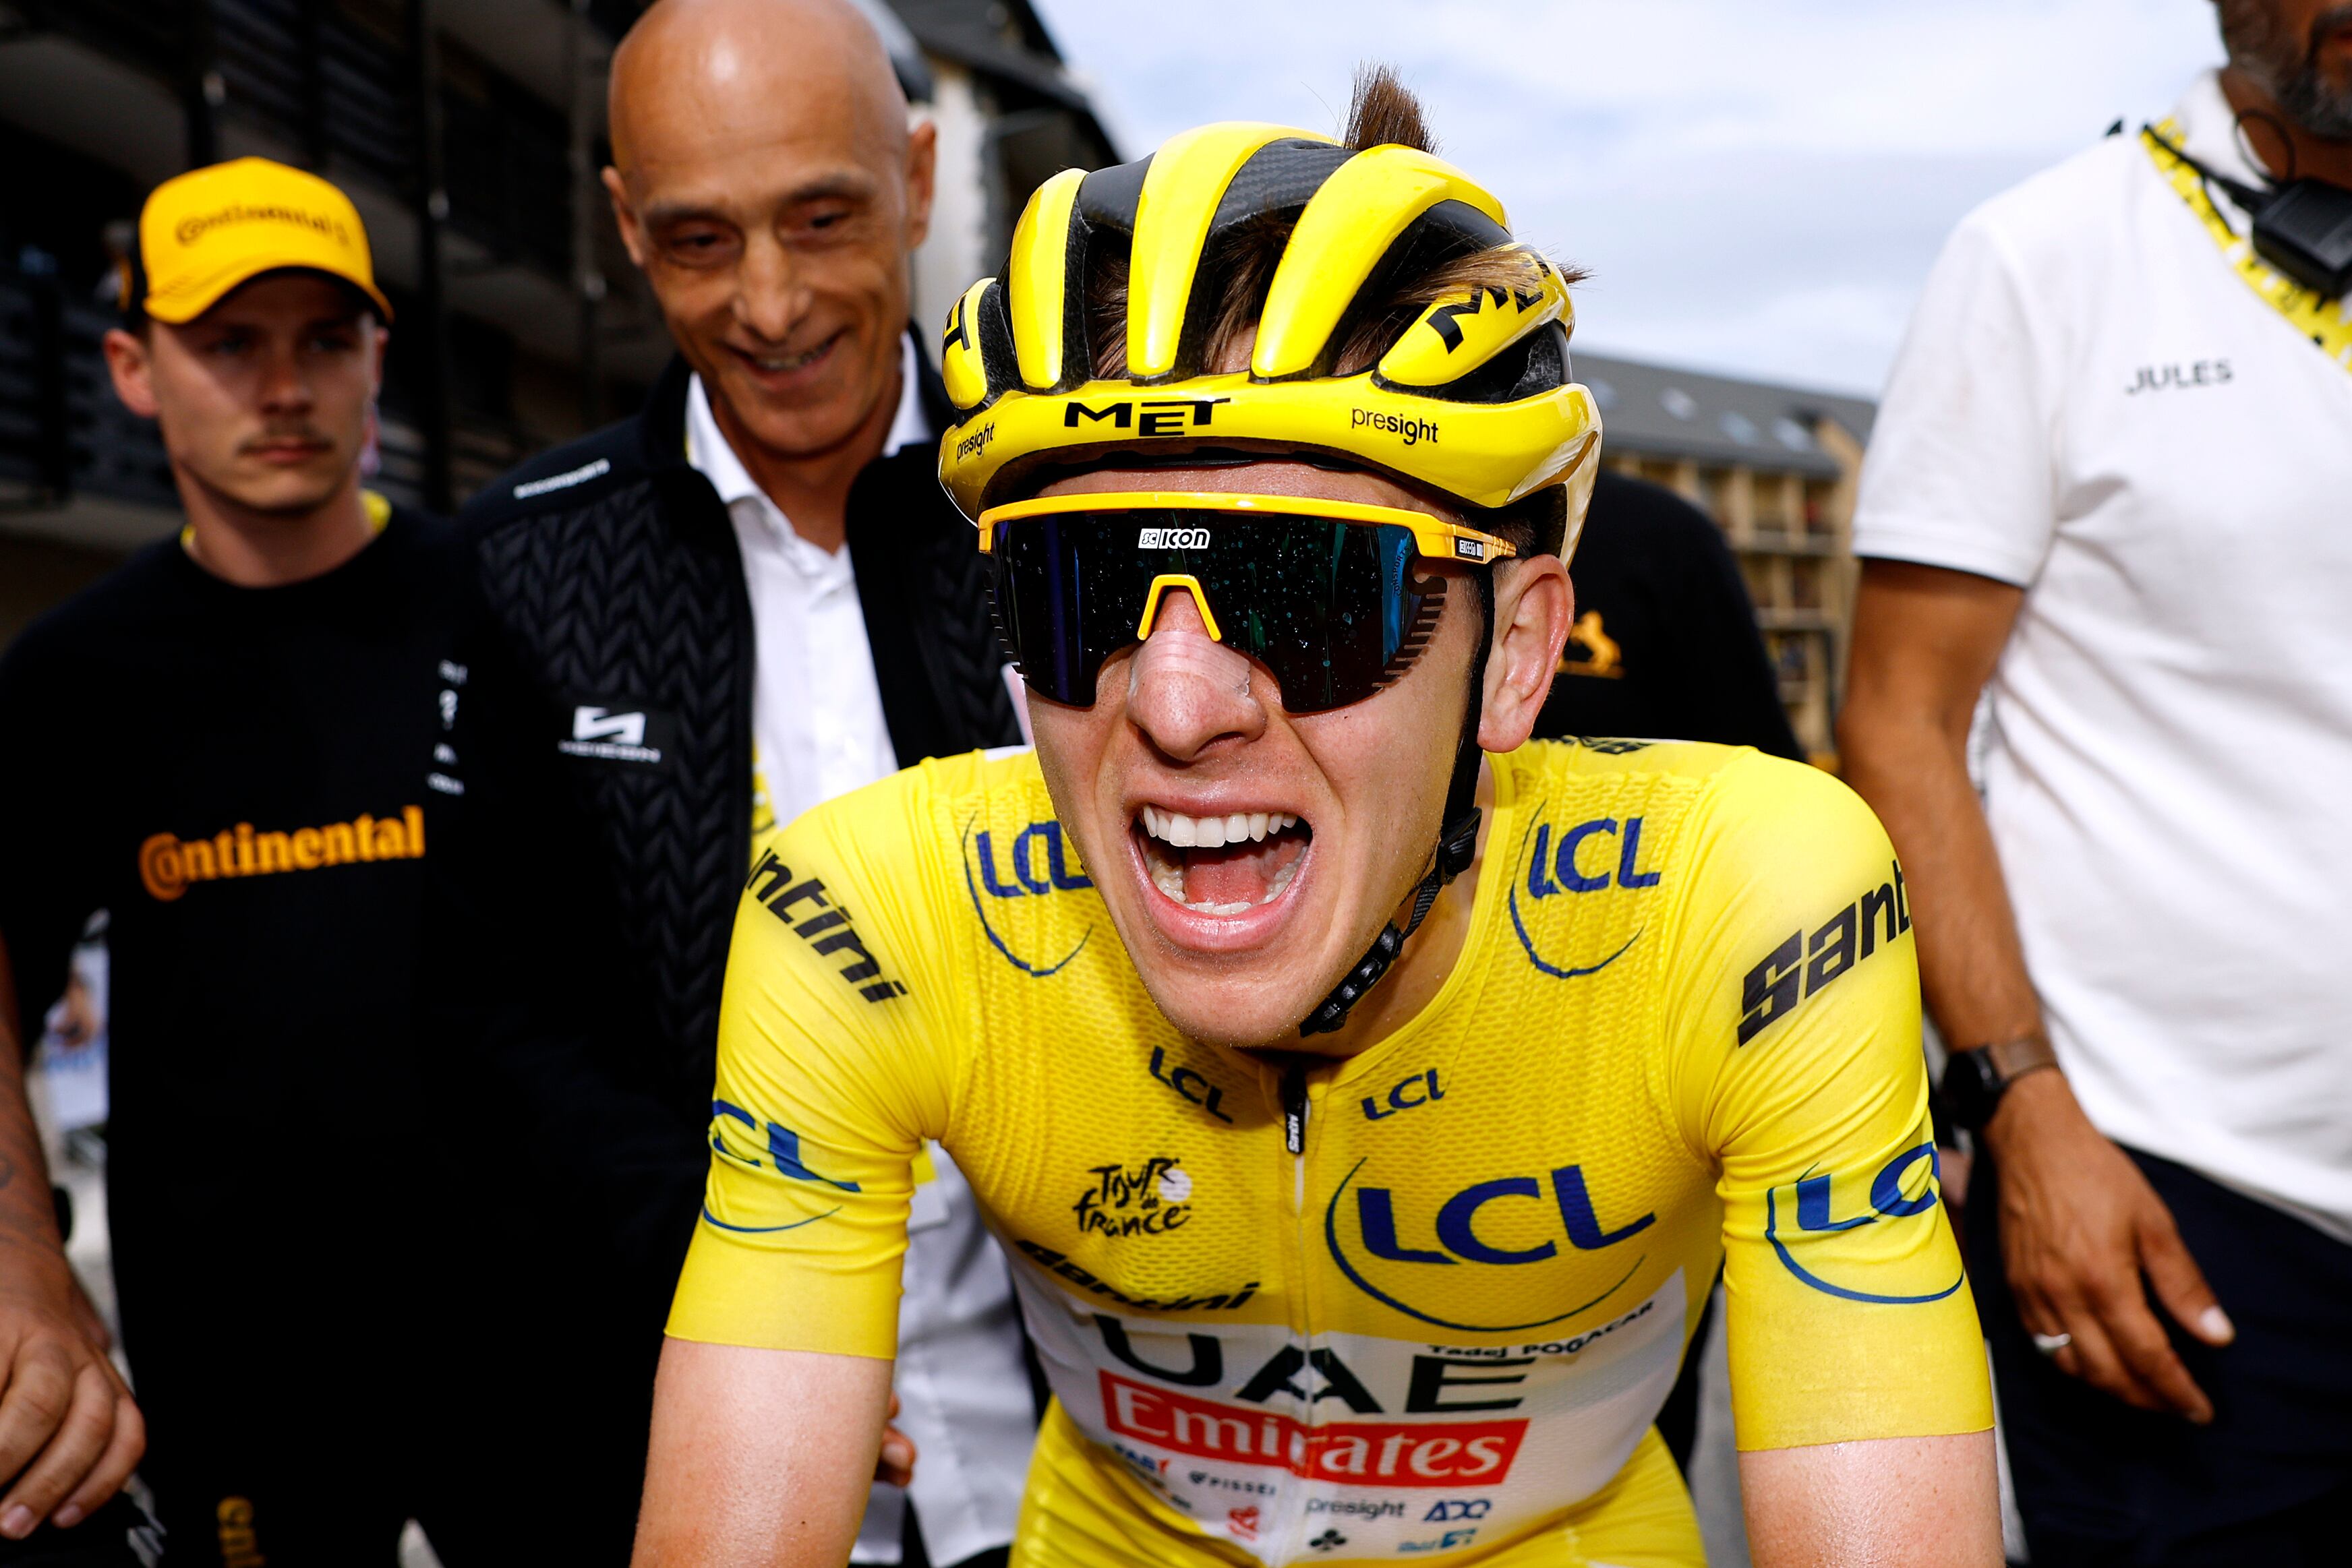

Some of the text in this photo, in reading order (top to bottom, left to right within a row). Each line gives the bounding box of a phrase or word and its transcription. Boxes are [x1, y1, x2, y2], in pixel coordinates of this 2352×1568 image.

[1064, 398, 1231, 437] MET
[2126, 359, 2233, 396] JULES
[956, 422, 995, 464] presight
[1351, 407, 1439, 446] presight
[138, 805, 425, 901] Continental
[1527, 816, 1662, 899] LCL
[747, 847, 908, 1003] ntini
[1737, 859, 1912, 1048] Sant
[1148, 1046, 1233, 1124] LCL
[1361, 1068, 1445, 1120] LCL
[712, 1099, 862, 1193] CL
[1796, 1141, 1941, 1232] LC
[1357, 1164, 1656, 1265] LCL
[1092, 1313, 1539, 1414] UAE
[1111, 1381, 1508, 1478] Emirates
[1304, 1497, 1406, 1522] presight
